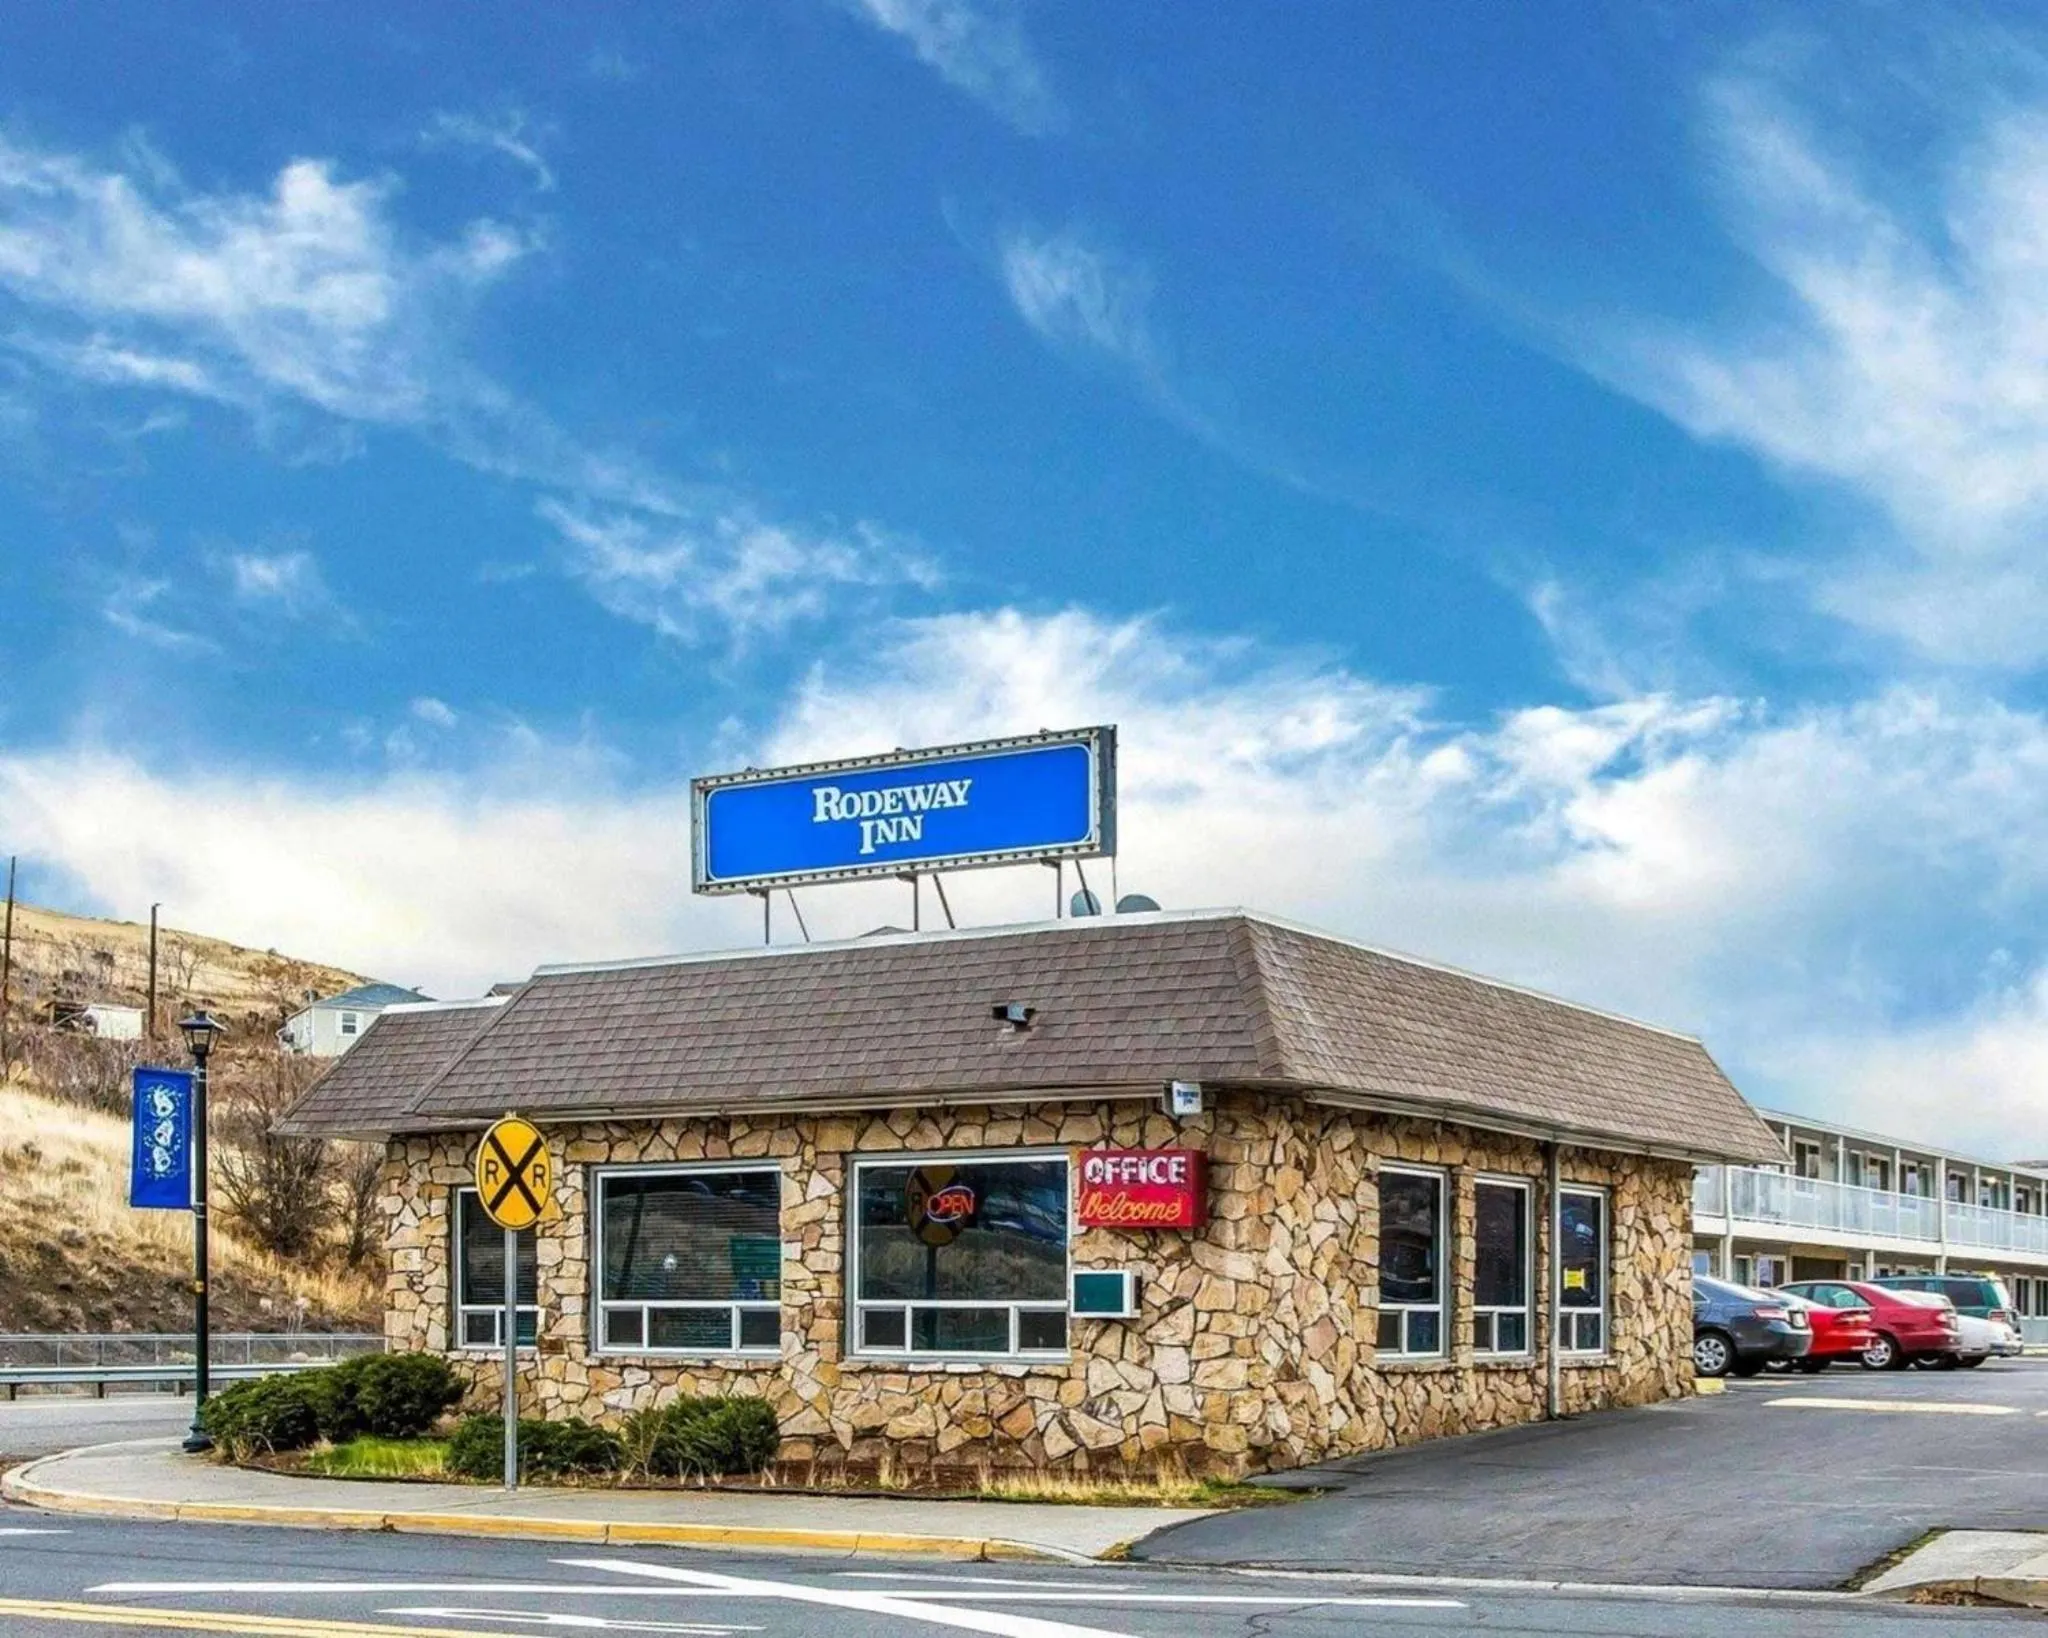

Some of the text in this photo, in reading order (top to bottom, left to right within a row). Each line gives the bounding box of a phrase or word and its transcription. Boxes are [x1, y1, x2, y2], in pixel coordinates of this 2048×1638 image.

[812, 778, 973, 823] RODEWAY
[859, 814, 924, 855] INN
[1084, 1156, 1187, 1185] OFFICE
[928, 1193, 975, 1216] OPEN
[1079, 1181, 1188, 1221] Welcome
